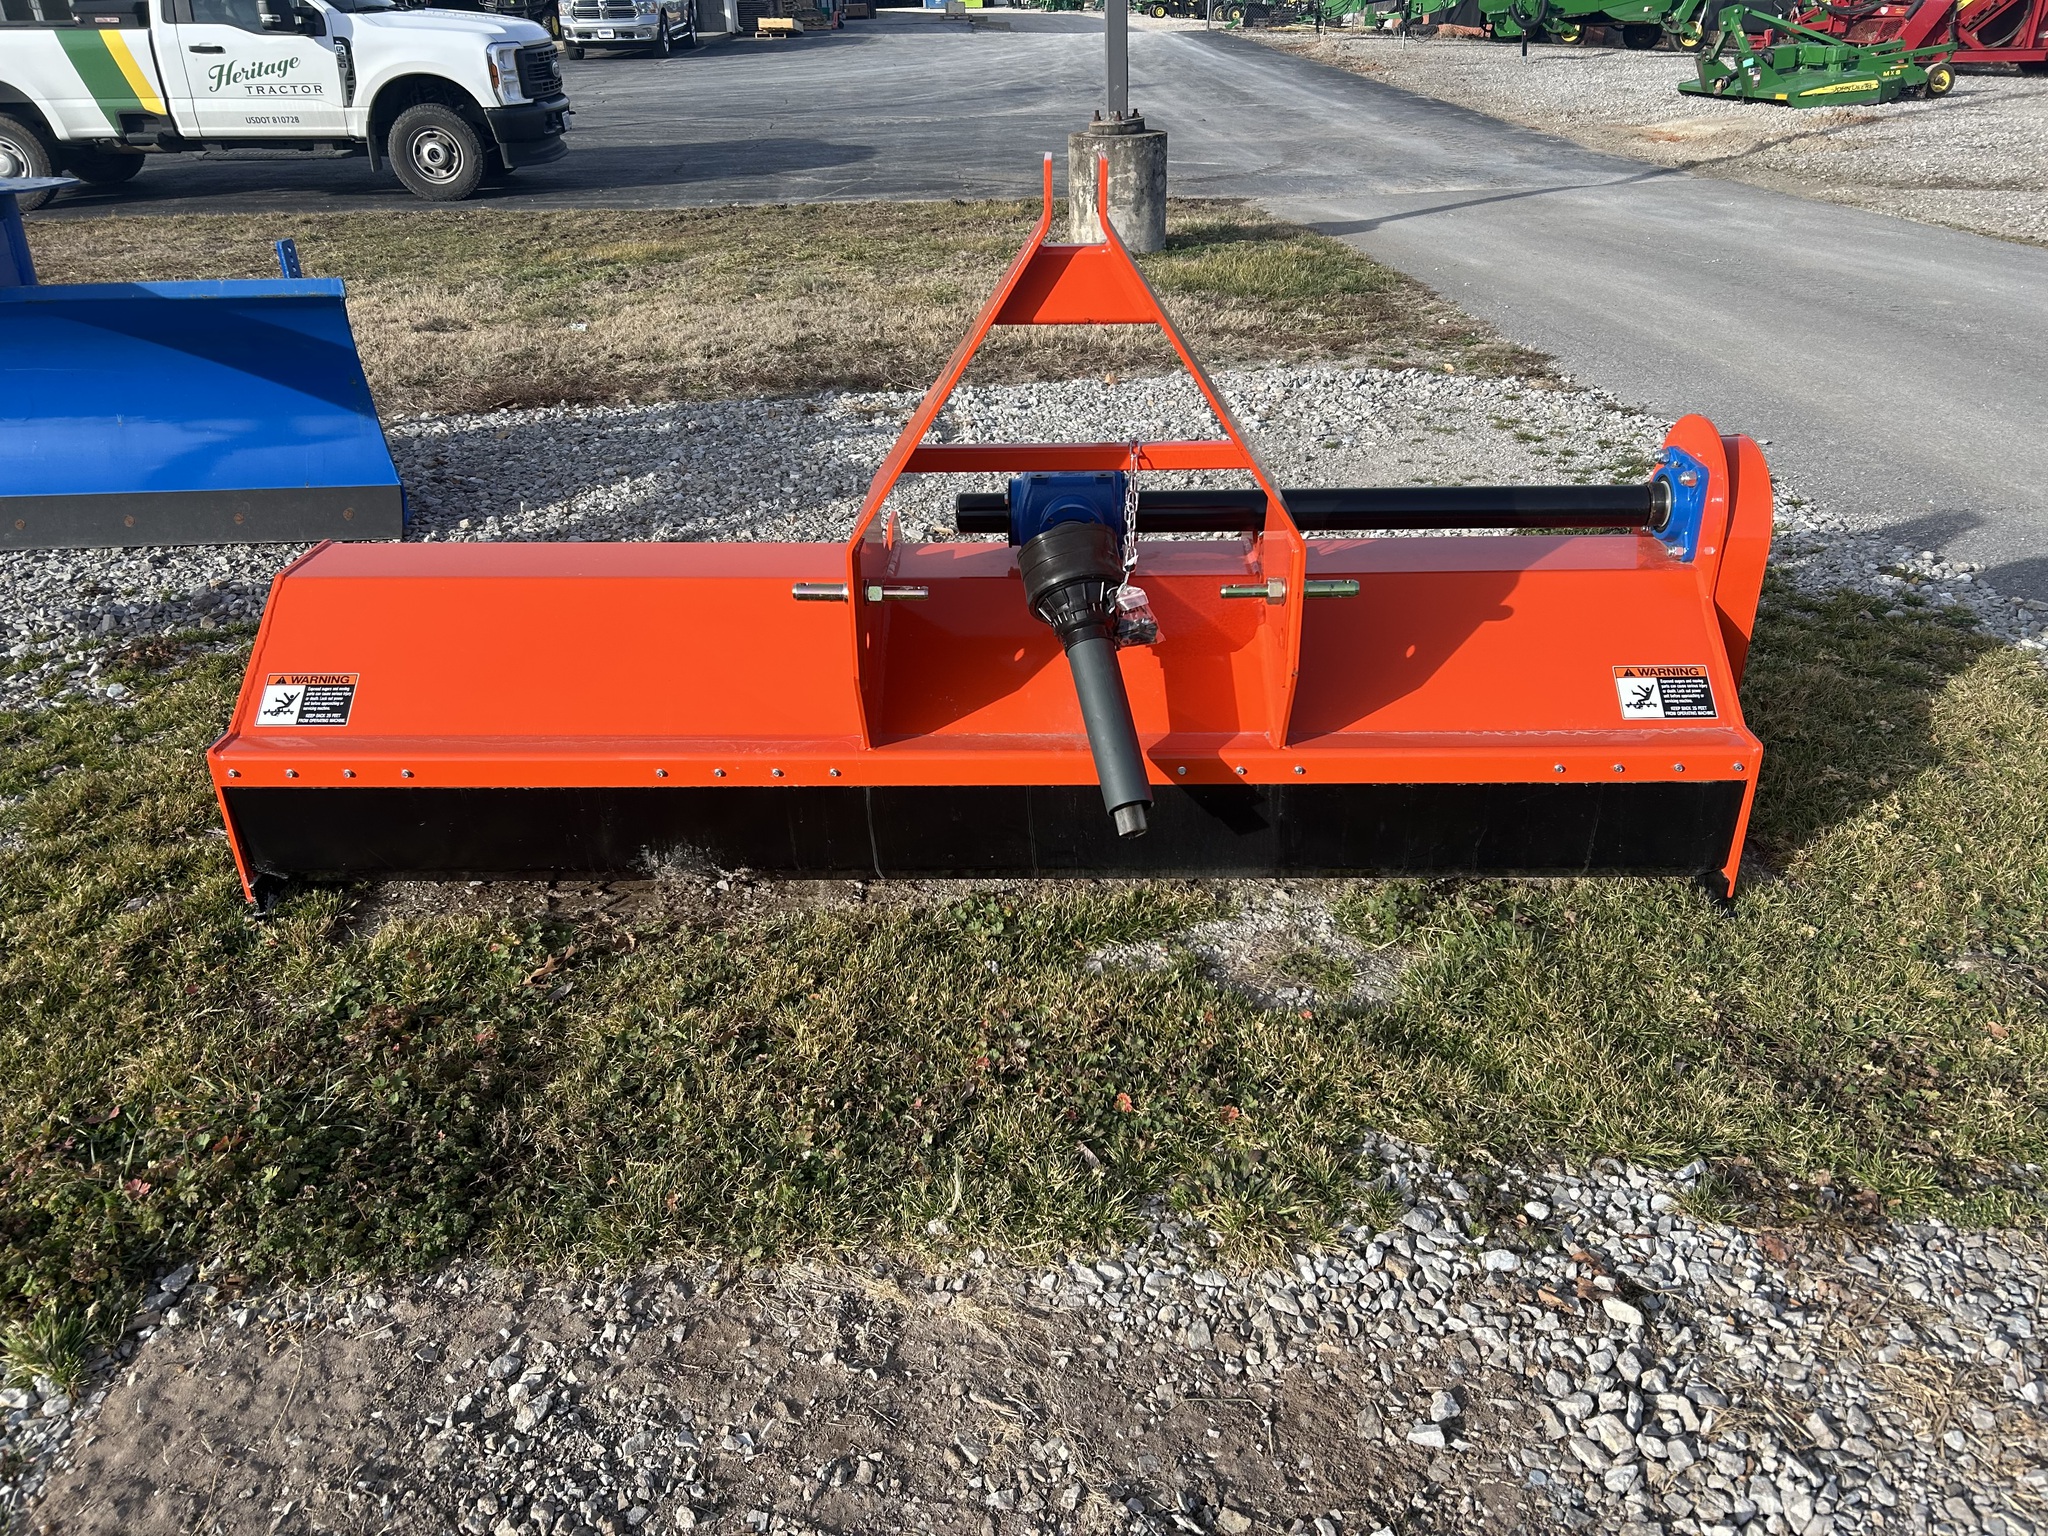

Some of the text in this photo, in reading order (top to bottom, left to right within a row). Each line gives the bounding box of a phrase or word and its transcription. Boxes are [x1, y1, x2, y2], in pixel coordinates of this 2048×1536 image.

[208, 56, 301, 93] Heritage
[245, 85, 324, 95] TRACTOR
[245, 116, 300, 125] USDOT 810728
[1637, 668, 1699, 676] WARNING
[291, 676, 350, 684] WARNING
